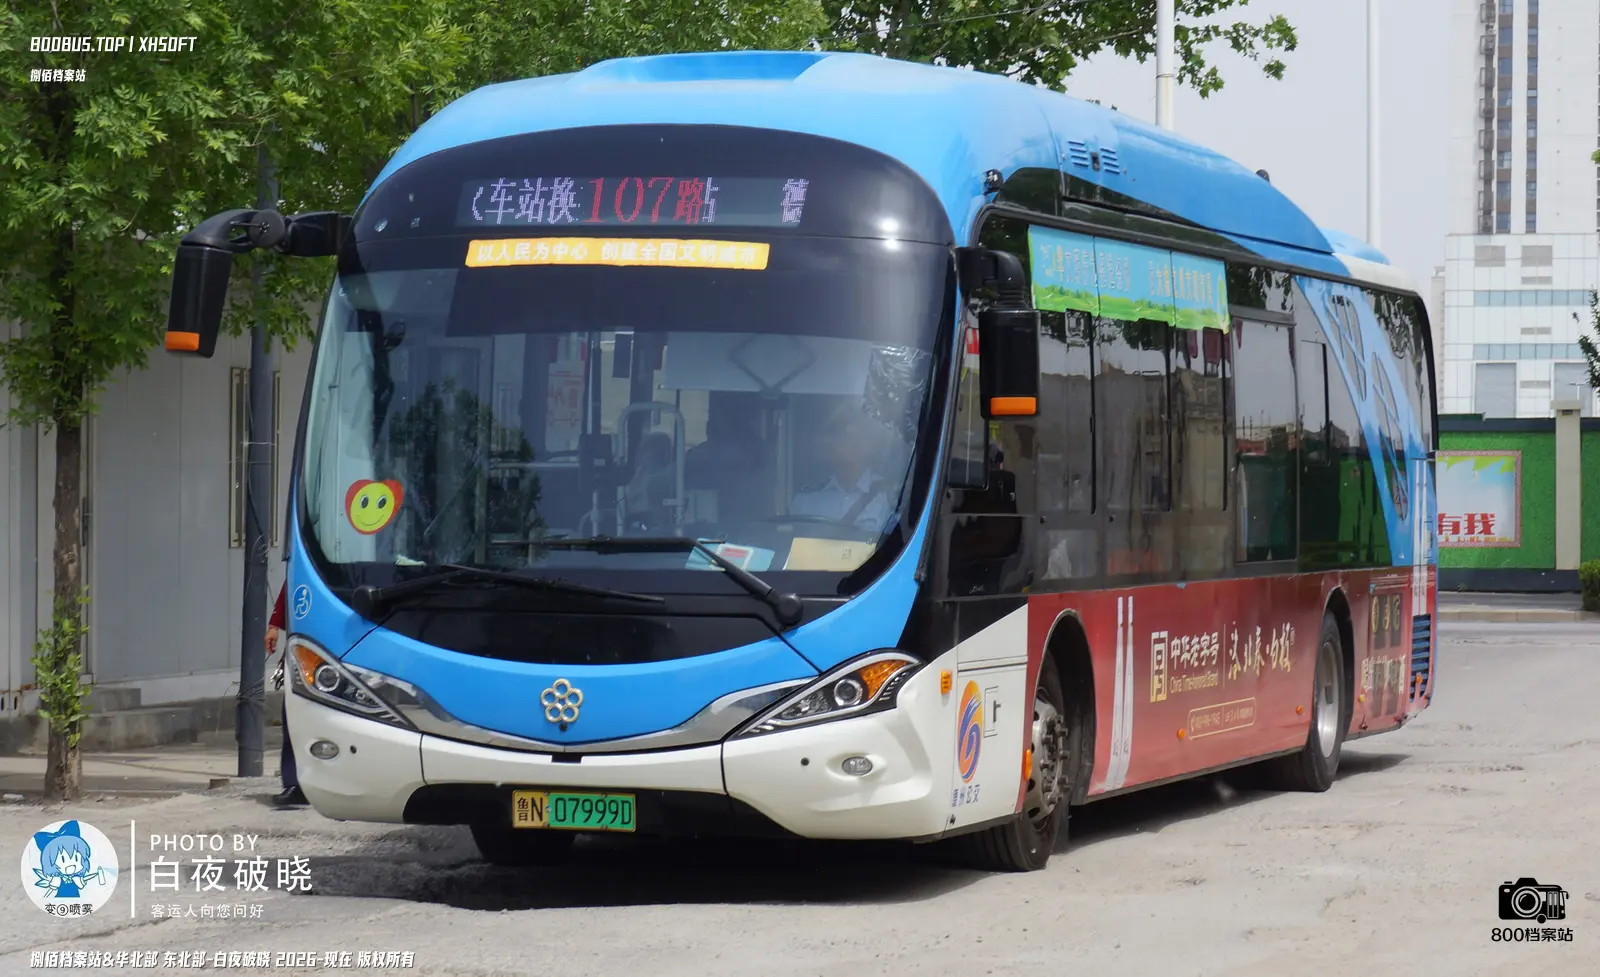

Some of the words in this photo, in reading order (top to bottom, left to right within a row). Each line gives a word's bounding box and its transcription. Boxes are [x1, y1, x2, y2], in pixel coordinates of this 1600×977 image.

[477, 241, 589, 262] 以人民为中心
[1170, 631, 1220, 670] 中华老字号
